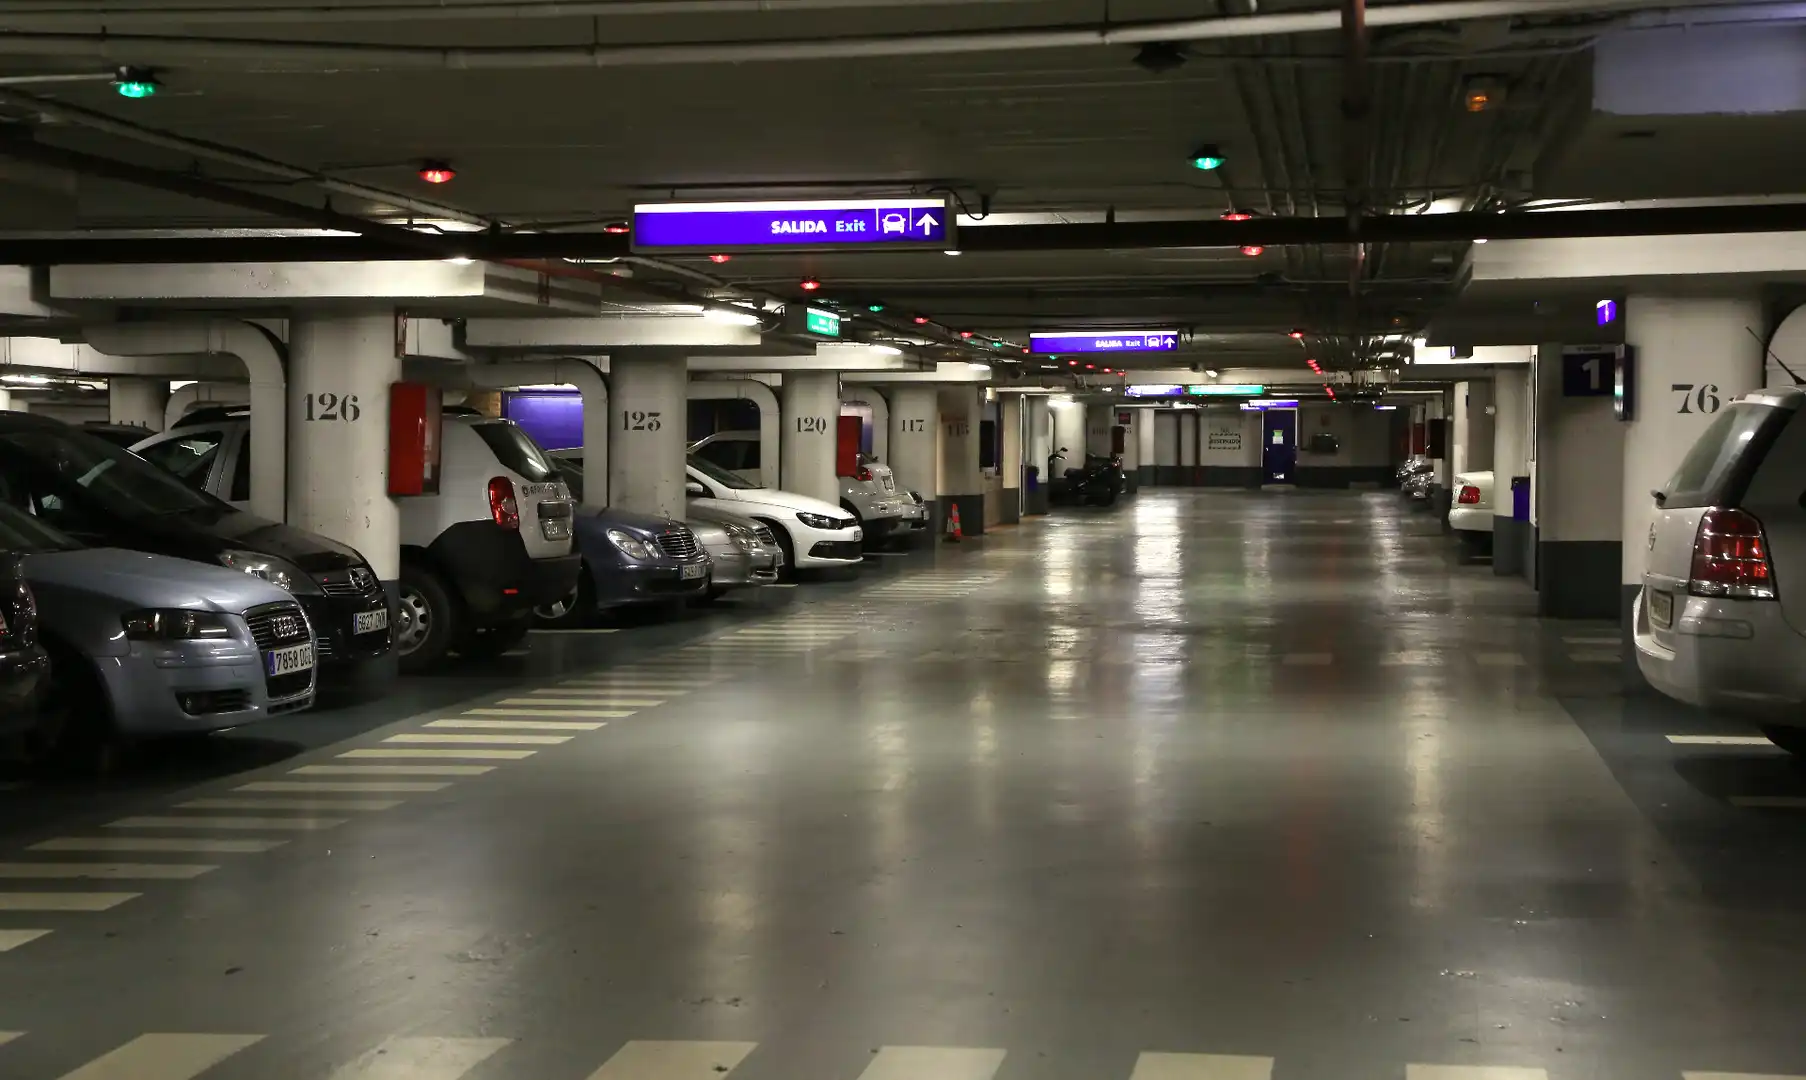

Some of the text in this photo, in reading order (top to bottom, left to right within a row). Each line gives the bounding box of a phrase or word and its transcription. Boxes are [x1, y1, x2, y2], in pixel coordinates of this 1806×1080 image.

[771, 220, 865, 234] SALIDA Exit
[1582, 359, 1600, 390] 1
[303, 392, 360, 423] 126
[1671, 384, 1720, 414] 76
[621, 410, 661, 431] 123
[797, 416, 827, 435] 120
[902, 419, 924, 431] 117
[275, 650, 299, 671] 7858
